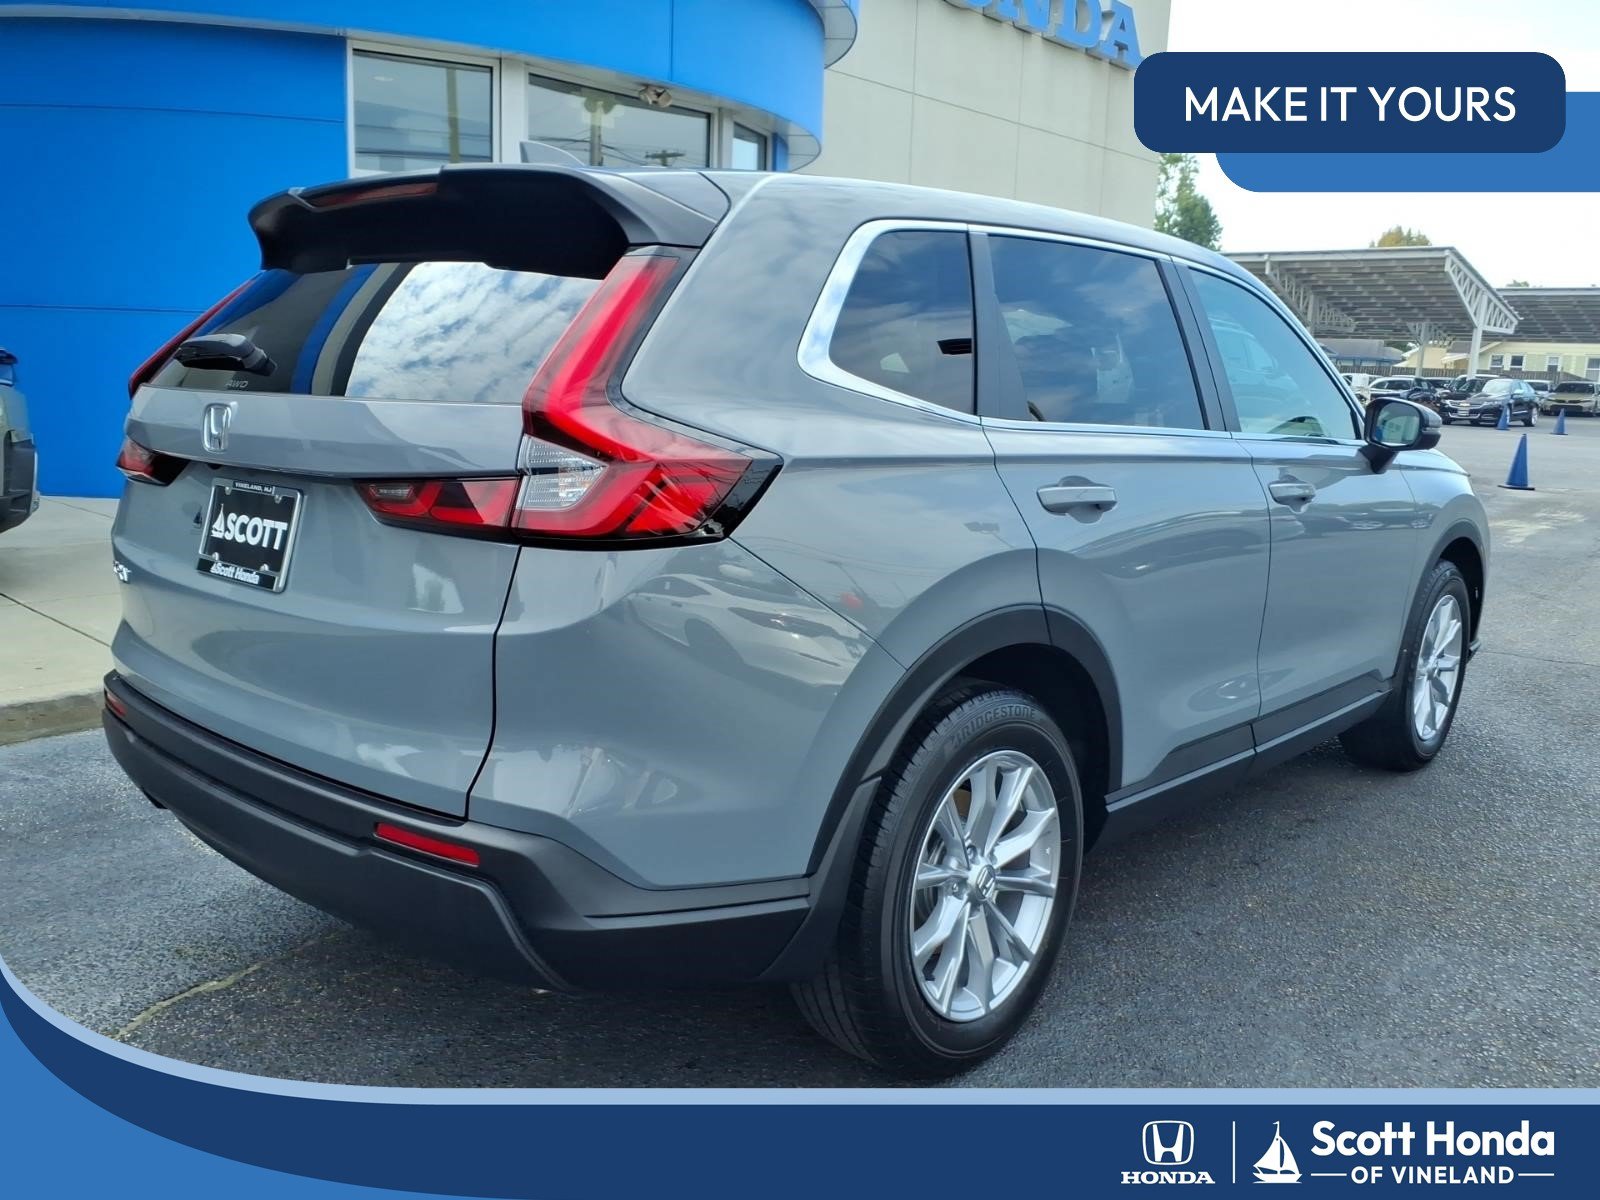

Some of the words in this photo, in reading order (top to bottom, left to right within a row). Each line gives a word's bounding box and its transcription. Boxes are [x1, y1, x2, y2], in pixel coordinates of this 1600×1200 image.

[224, 512, 288, 550] SCOTT
[216, 562, 235, 577] Scott
[235, 567, 260, 584] Honda
[951, 704, 1036, 749] BRIDGESTONE
